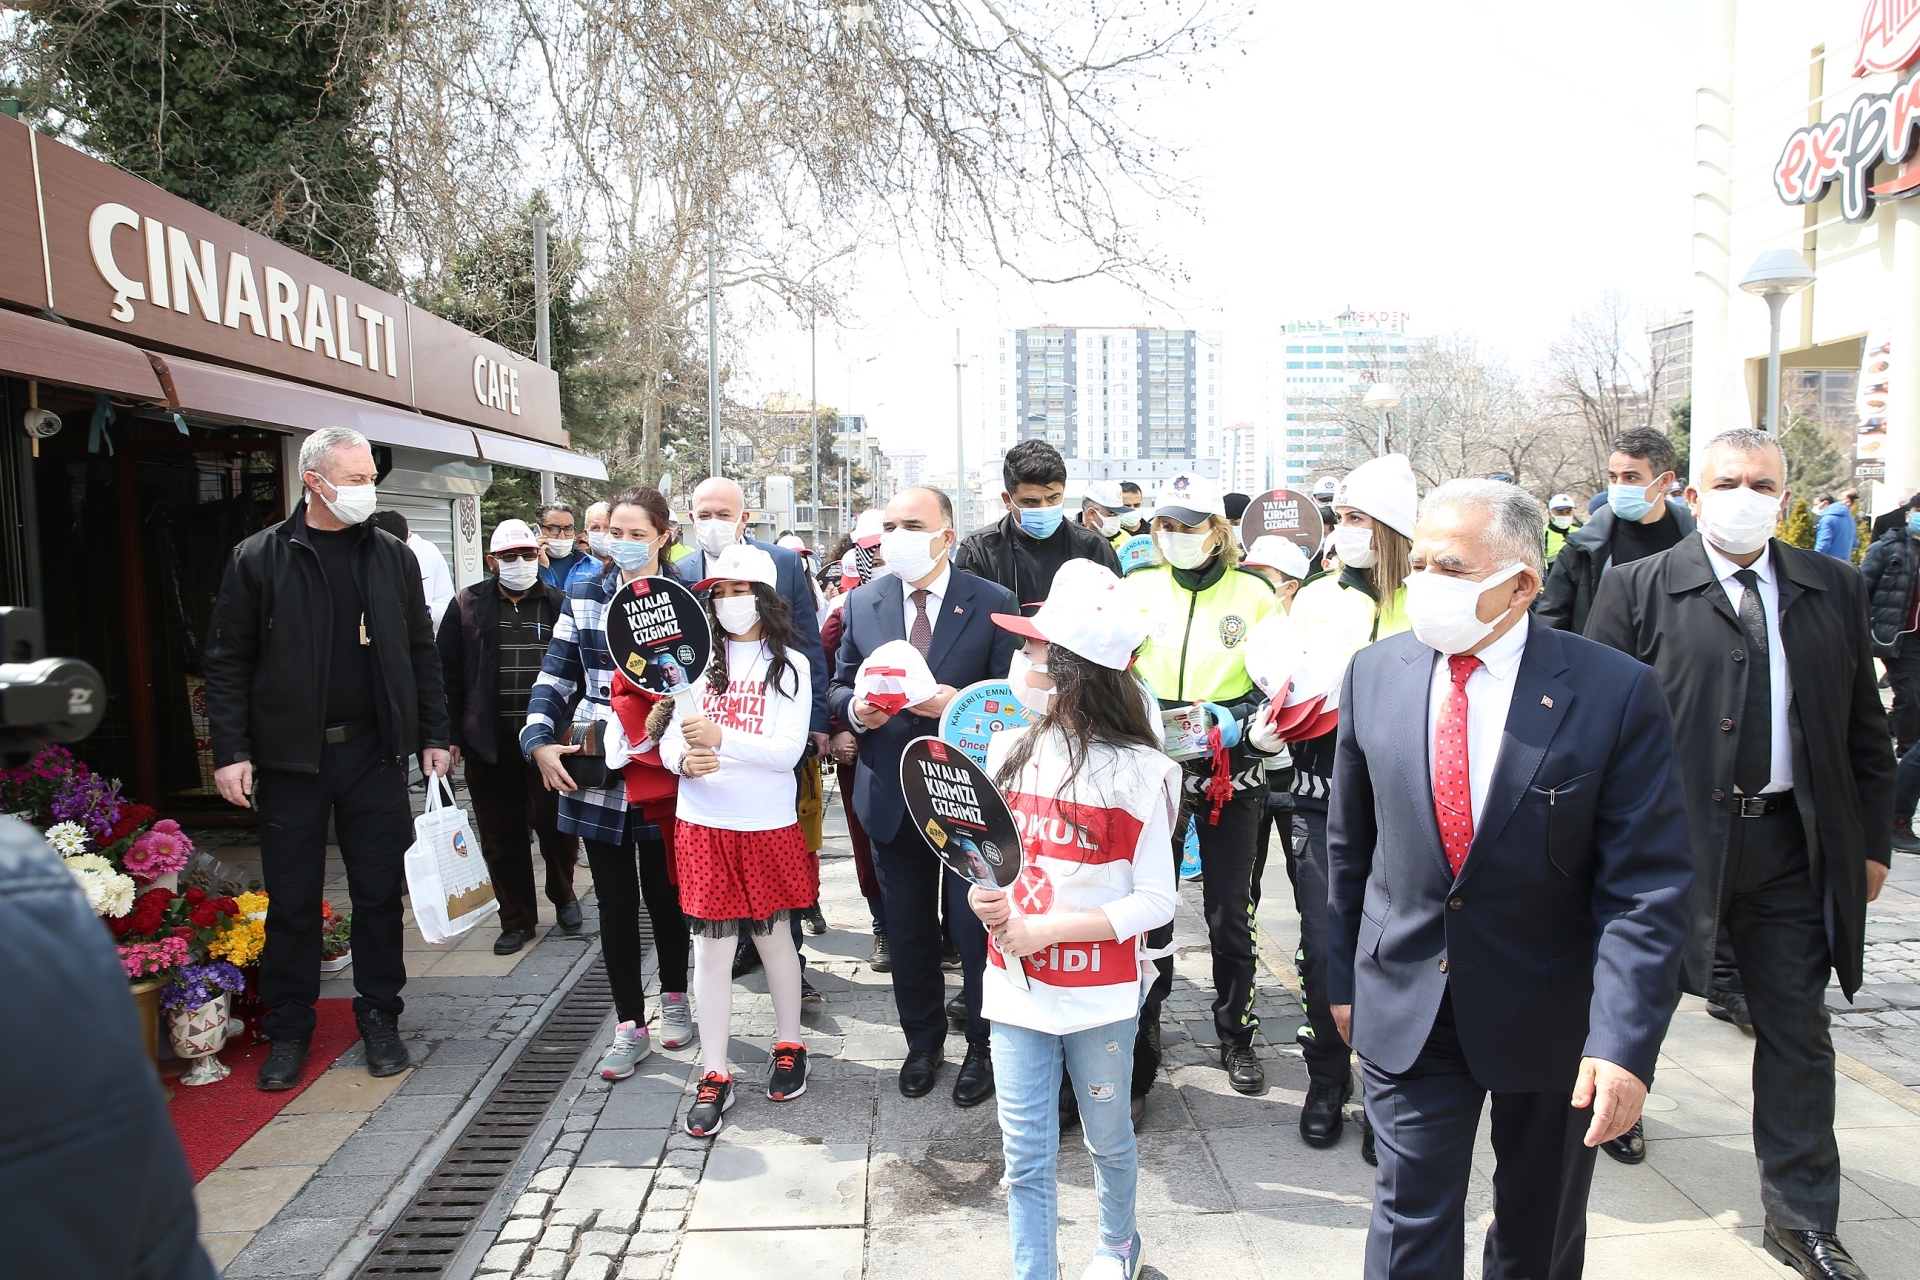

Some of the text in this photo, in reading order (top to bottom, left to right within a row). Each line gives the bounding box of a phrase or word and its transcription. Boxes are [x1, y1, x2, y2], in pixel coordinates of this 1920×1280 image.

[89, 202, 398, 378] ÇINARALTI
[1351, 311, 1410, 322] TEKDEN
[473, 354, 522, 417] CAFE
[1262, 500, 1298, 511] YAYALAR
[1263, 508, 1299, 520] KIRMIZI
[622, 591, 671, 616] YAYALAR
[627, 604, 677, 631] KIRMIZI
[632, 619, 682, 646] ÇİZGİMİZ
[951, 695, 976, 727] KAYSERİ
[975, 692, 985, 700] İL
[917, 759, 973, 786] YAYALAR
[923, 777, 980, 806] KIRMIZI
[931, 797, 986, 826] ÇİZGİMİZ
